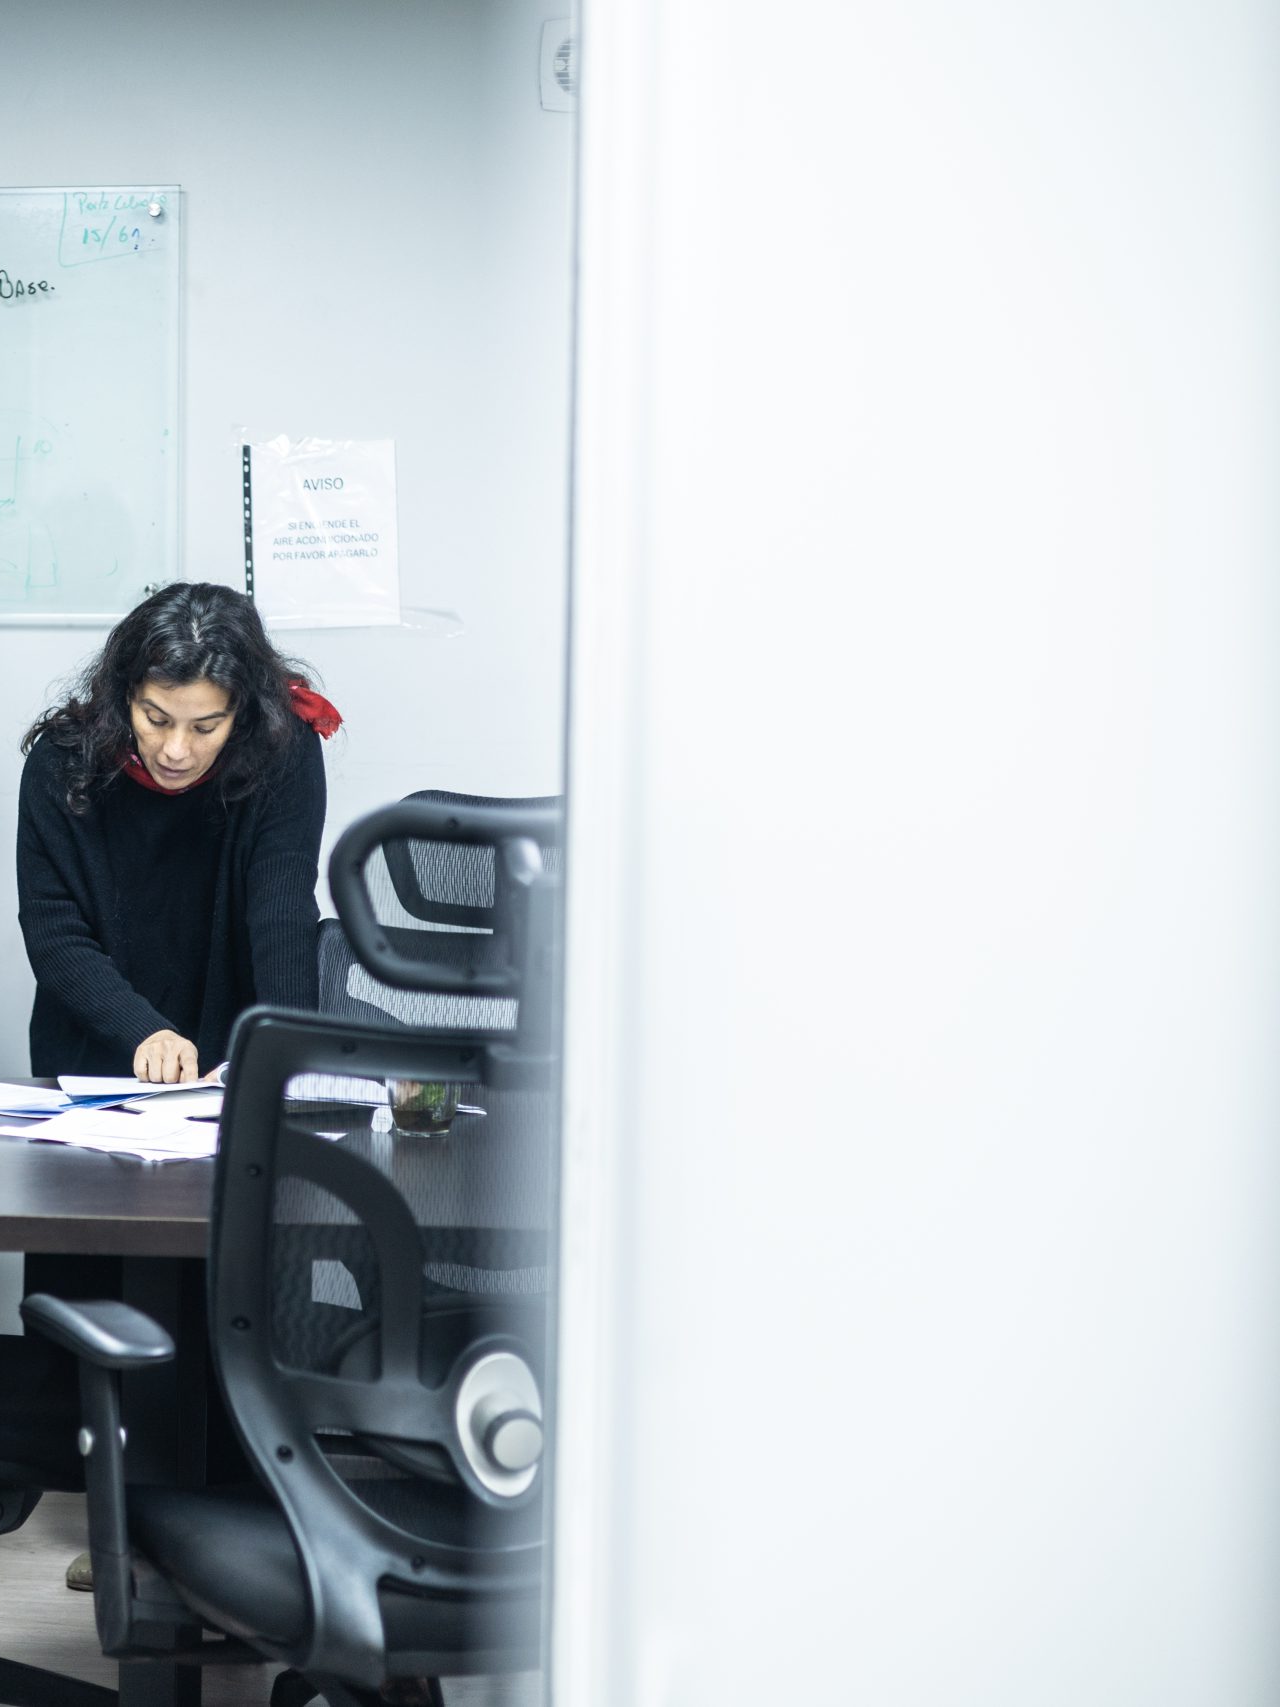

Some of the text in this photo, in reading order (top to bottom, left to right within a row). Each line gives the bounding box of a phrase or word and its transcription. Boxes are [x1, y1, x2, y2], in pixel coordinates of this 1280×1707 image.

[303, 477, 344, 490] AVISO
[273, 533, 379, 546] AIRE ACONCIONADO
[272, 552, 293, 561] POR
[294, 550, 326, 560] FAVOR
